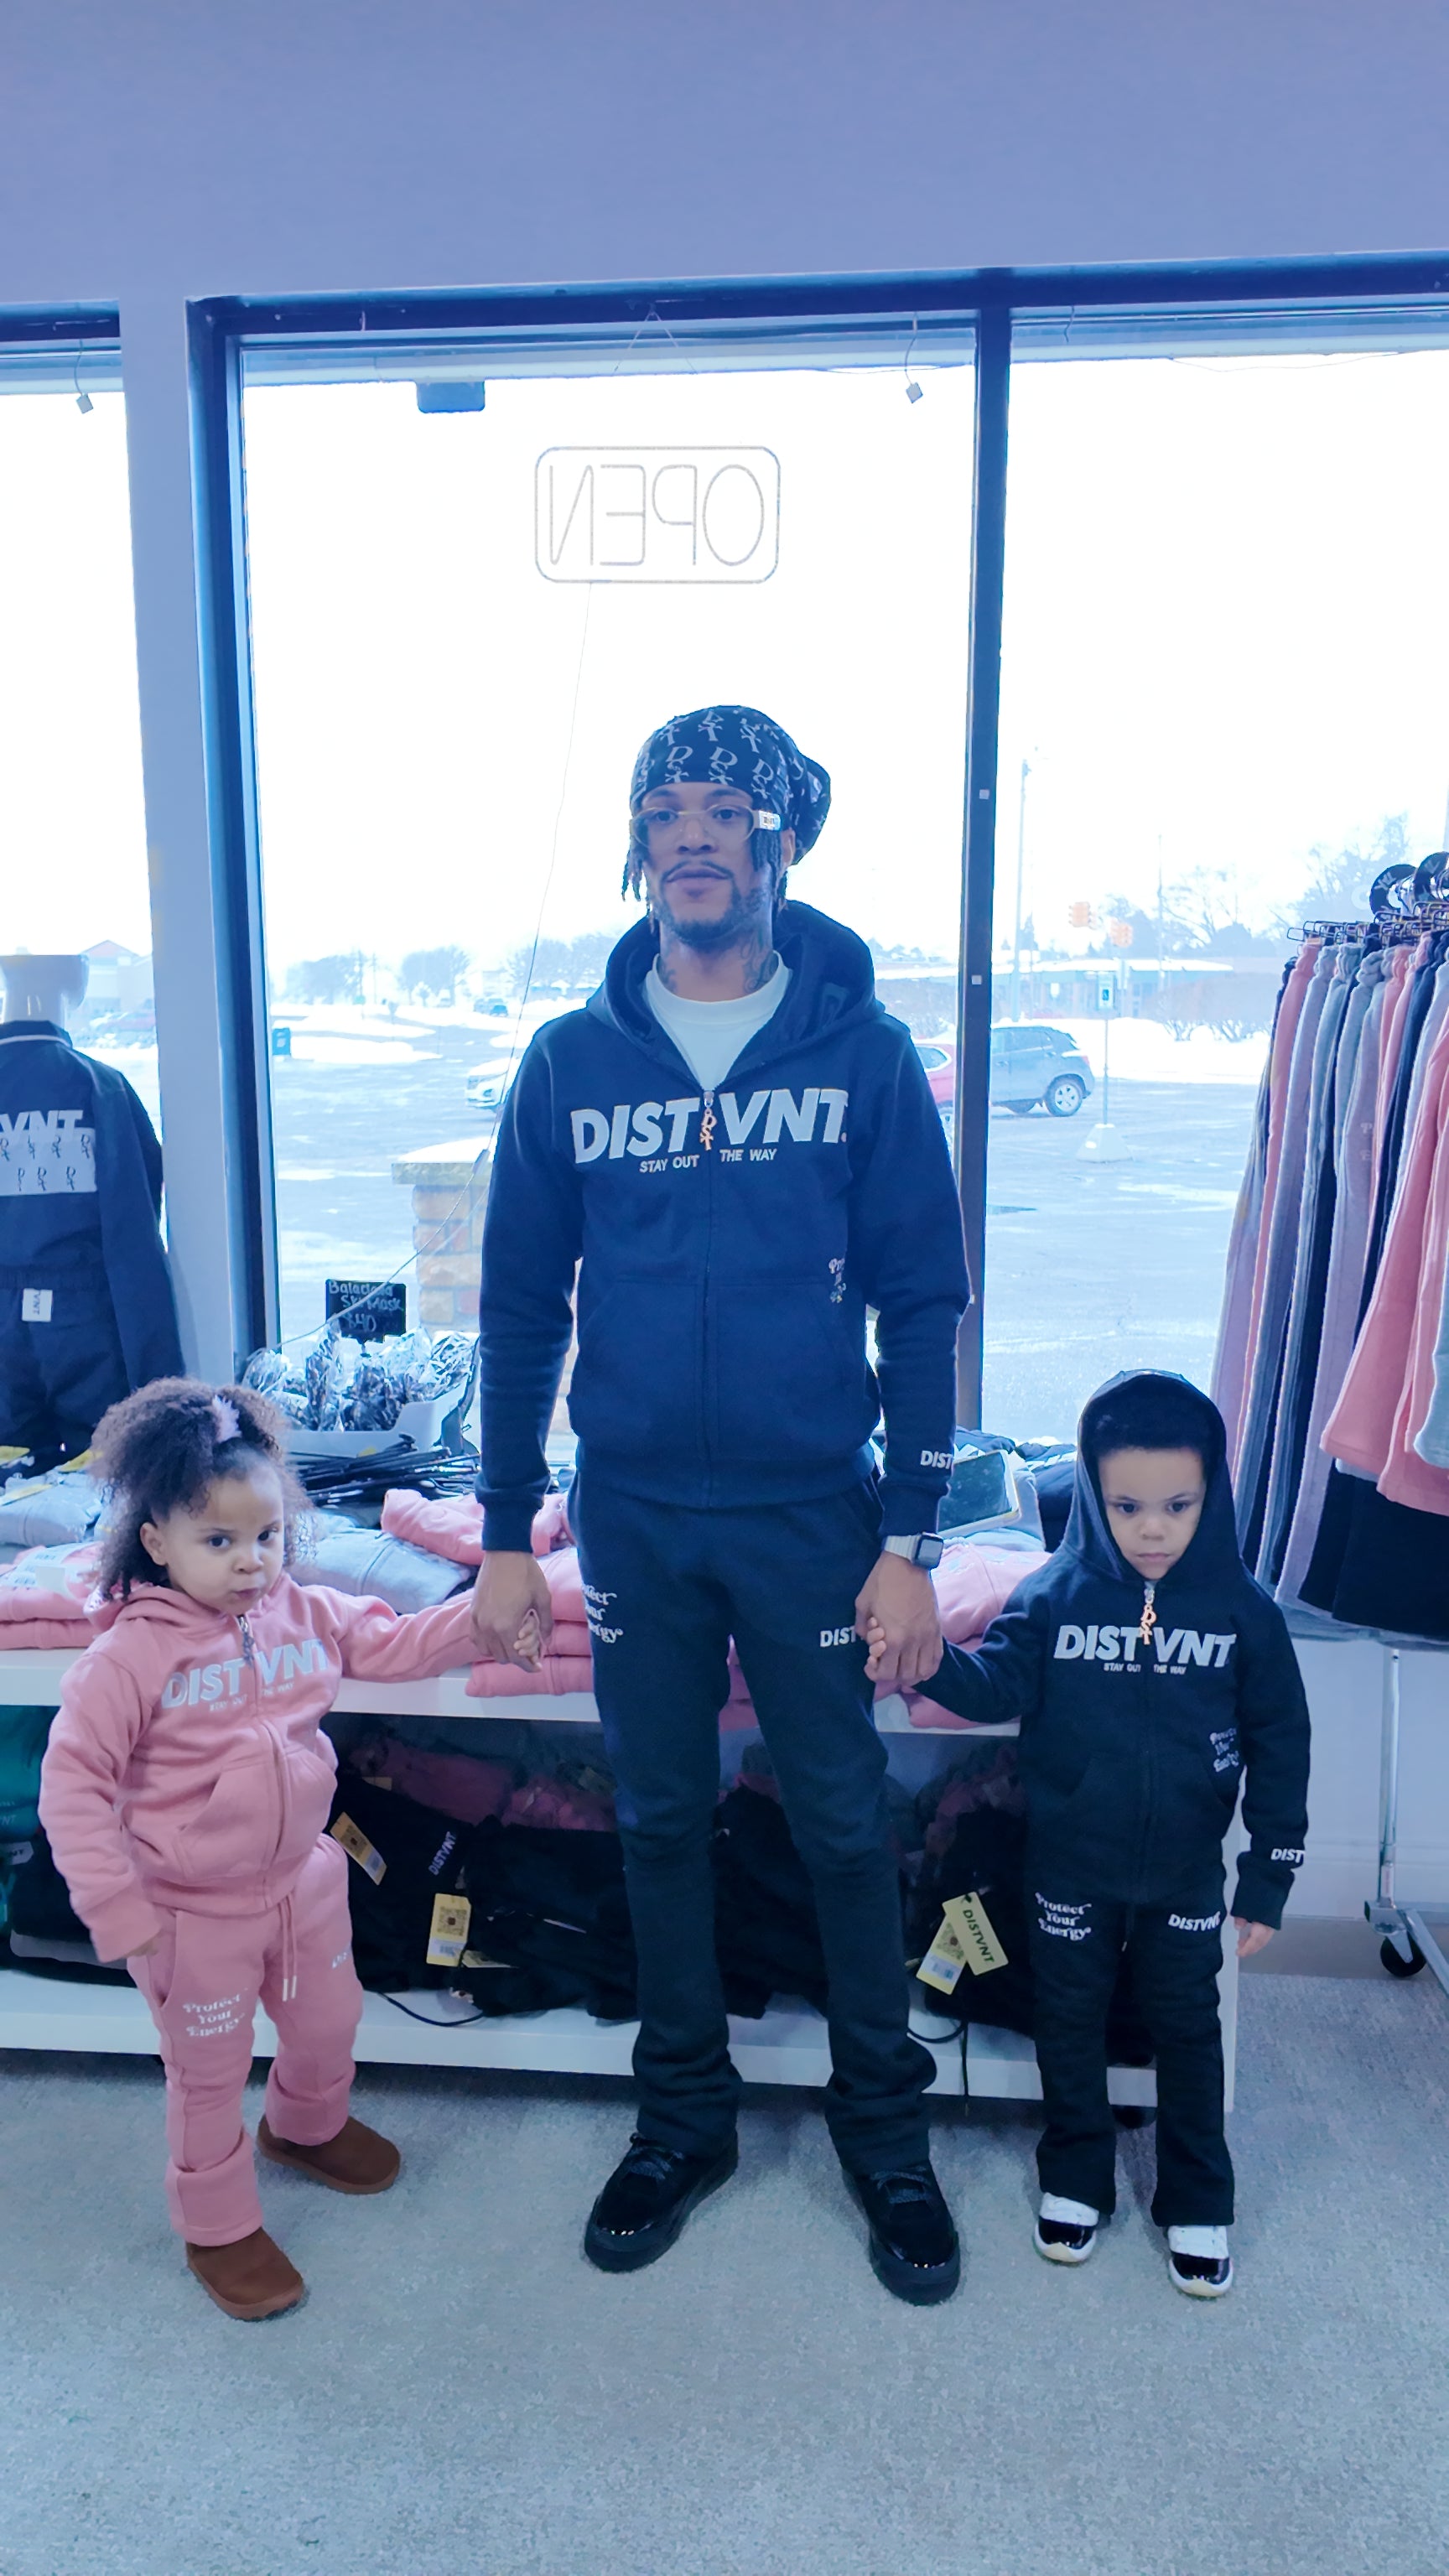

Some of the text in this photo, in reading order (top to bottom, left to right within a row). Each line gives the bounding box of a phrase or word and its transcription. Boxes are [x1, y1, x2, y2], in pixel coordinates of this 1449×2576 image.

[639, 1148, 778, 1173] STAY OUT THE WAY
[820, 1626, 859, 1648] DIST
[1104, 1663, 1187, 1675] STAY OUT THE WAY
[1035, 1892, 1092, 1915] Protect
[1045, 1909, 1080, 1927] Your
[963, 1909, 995, 1962] DISTVNT
